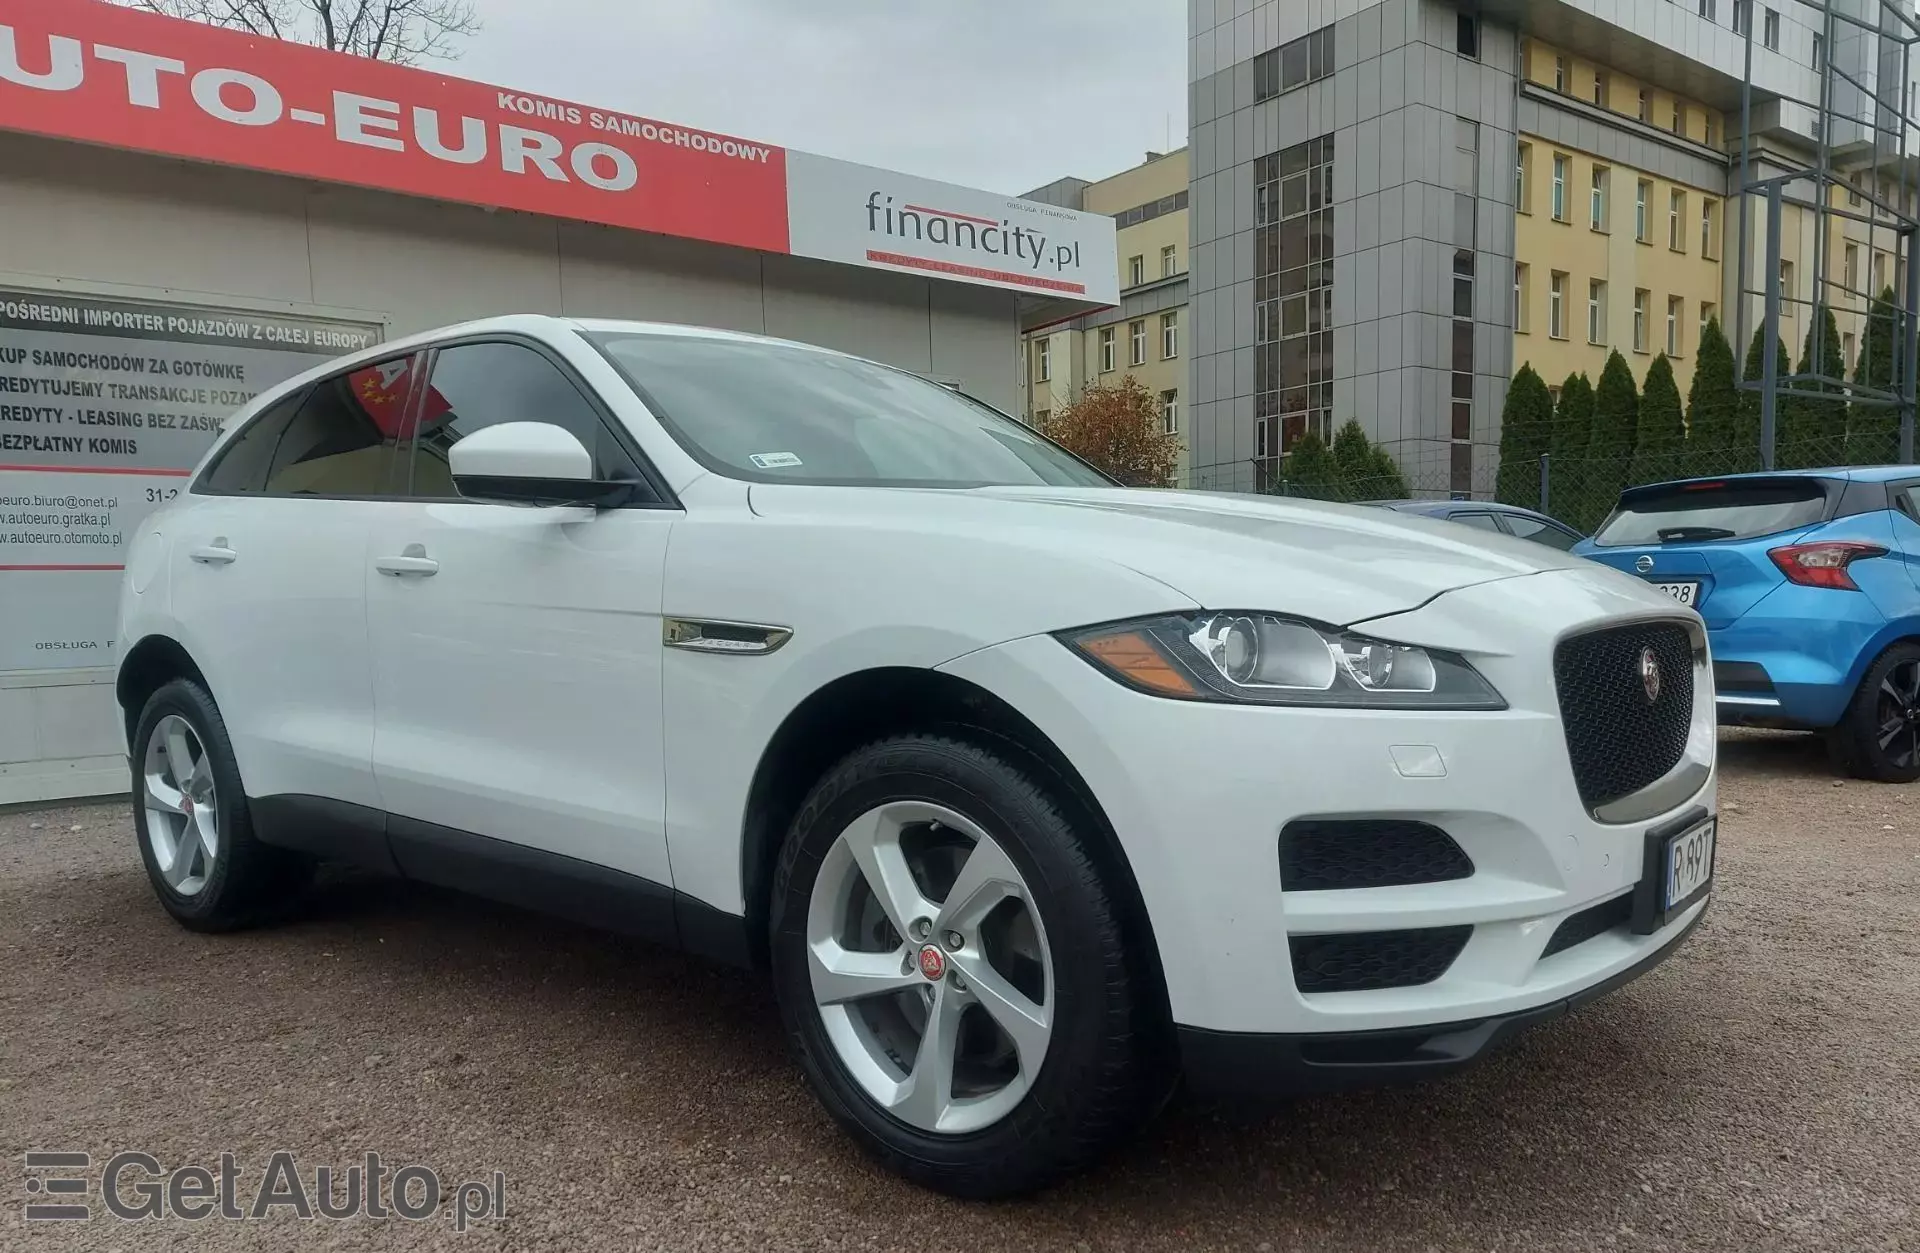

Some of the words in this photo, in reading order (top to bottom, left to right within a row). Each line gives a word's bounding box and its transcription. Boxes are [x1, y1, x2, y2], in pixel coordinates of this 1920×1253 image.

[498, 92, 582, 125] KOMIS
[589, 112, 771, 164] SAMOCHODOWY
[865, 191, 1081, 272] financity.pl
[84, 309, 164, 331] IMPORTER
[168, 316, 249, 339] POJAZDÓW
[252, 324, 262, 340] Z
[265, 326, 310, 345] CAŁEJ
[313, 331, 368, 349] EUROPY
[33, 349, 144, 373] SAMOCHODÓW
[149, 358, 169, 374] ZA
[173, 360, 245, 383] GOTÓWKĘ
[108, 383, 207, 404] TRANSAKCJE
[78, 409, 143, 428] LEASING
[147, 412, 177, 429] BEZ
[89, 437, 138, 454] KOMIS
[35, 640, 98, 650] OBSŁUGA
[1672, 844, 1683, 898] R
